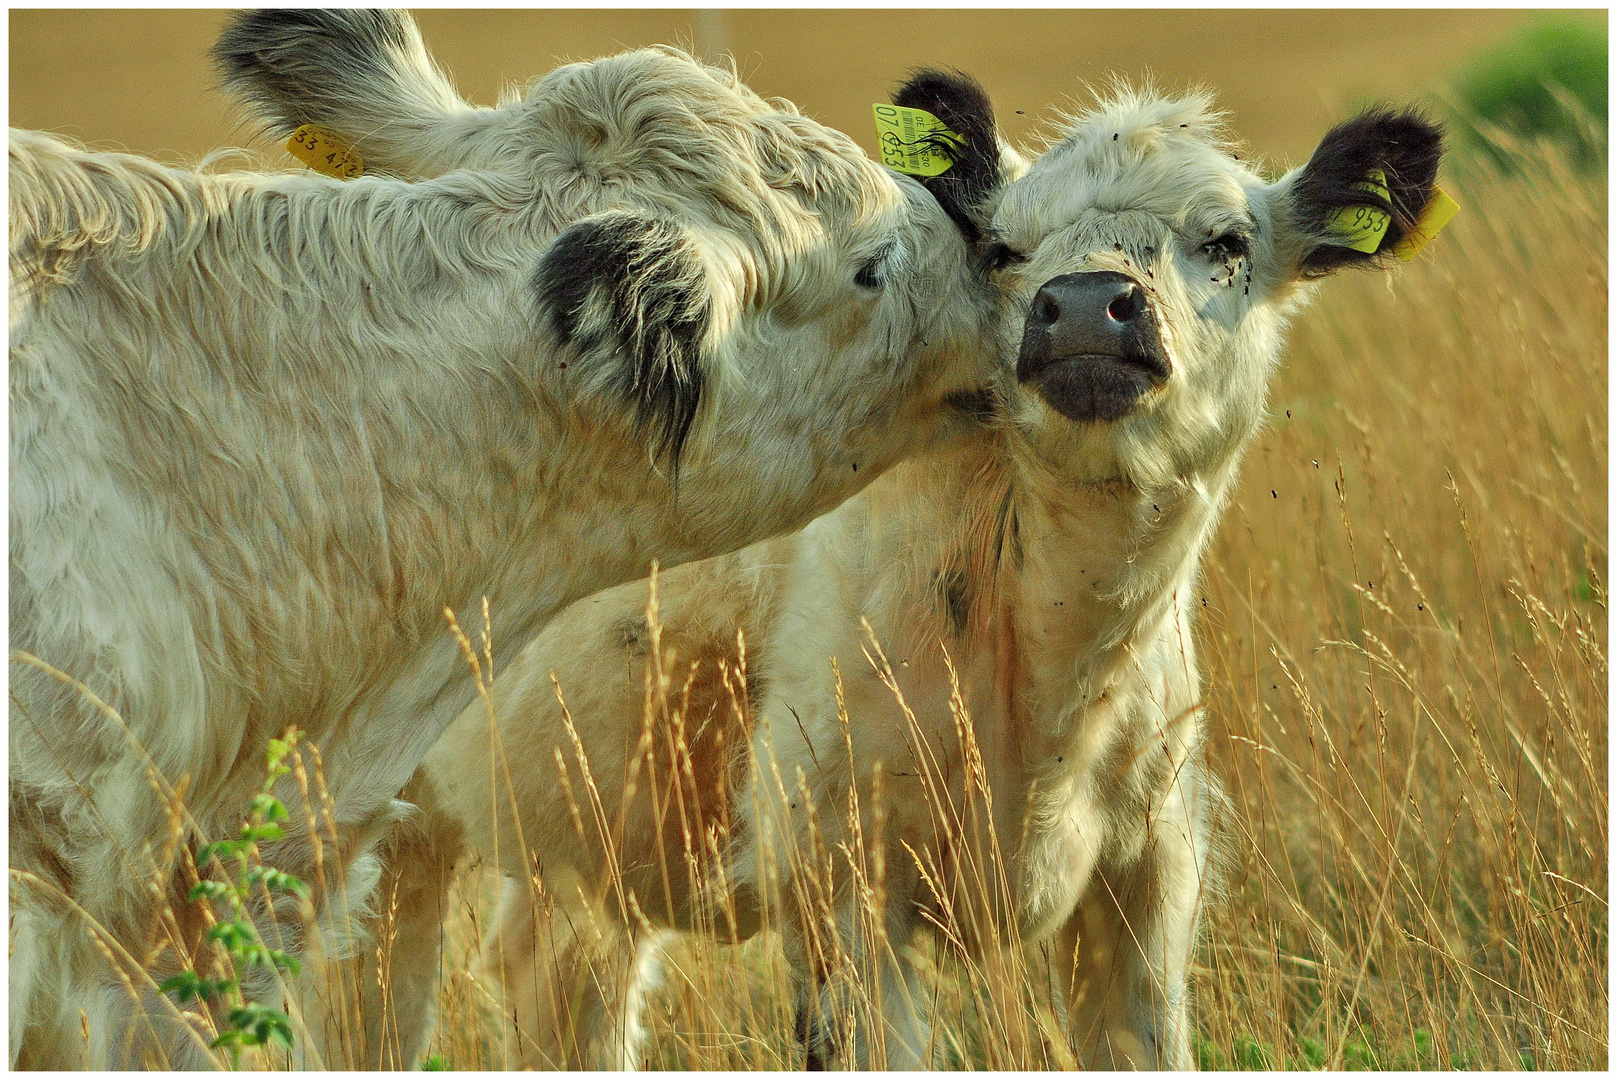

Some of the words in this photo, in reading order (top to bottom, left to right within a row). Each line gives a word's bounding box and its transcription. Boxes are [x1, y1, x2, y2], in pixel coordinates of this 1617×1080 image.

[876, 107, 898, 127] 07
[916, 116, 925, 128] DE
[295, 130, 318, 150] 33
[326, 153, 358, 177] 473
[882, 137, 906, 168] 953
[1352, 206, 1386, 232] 953
